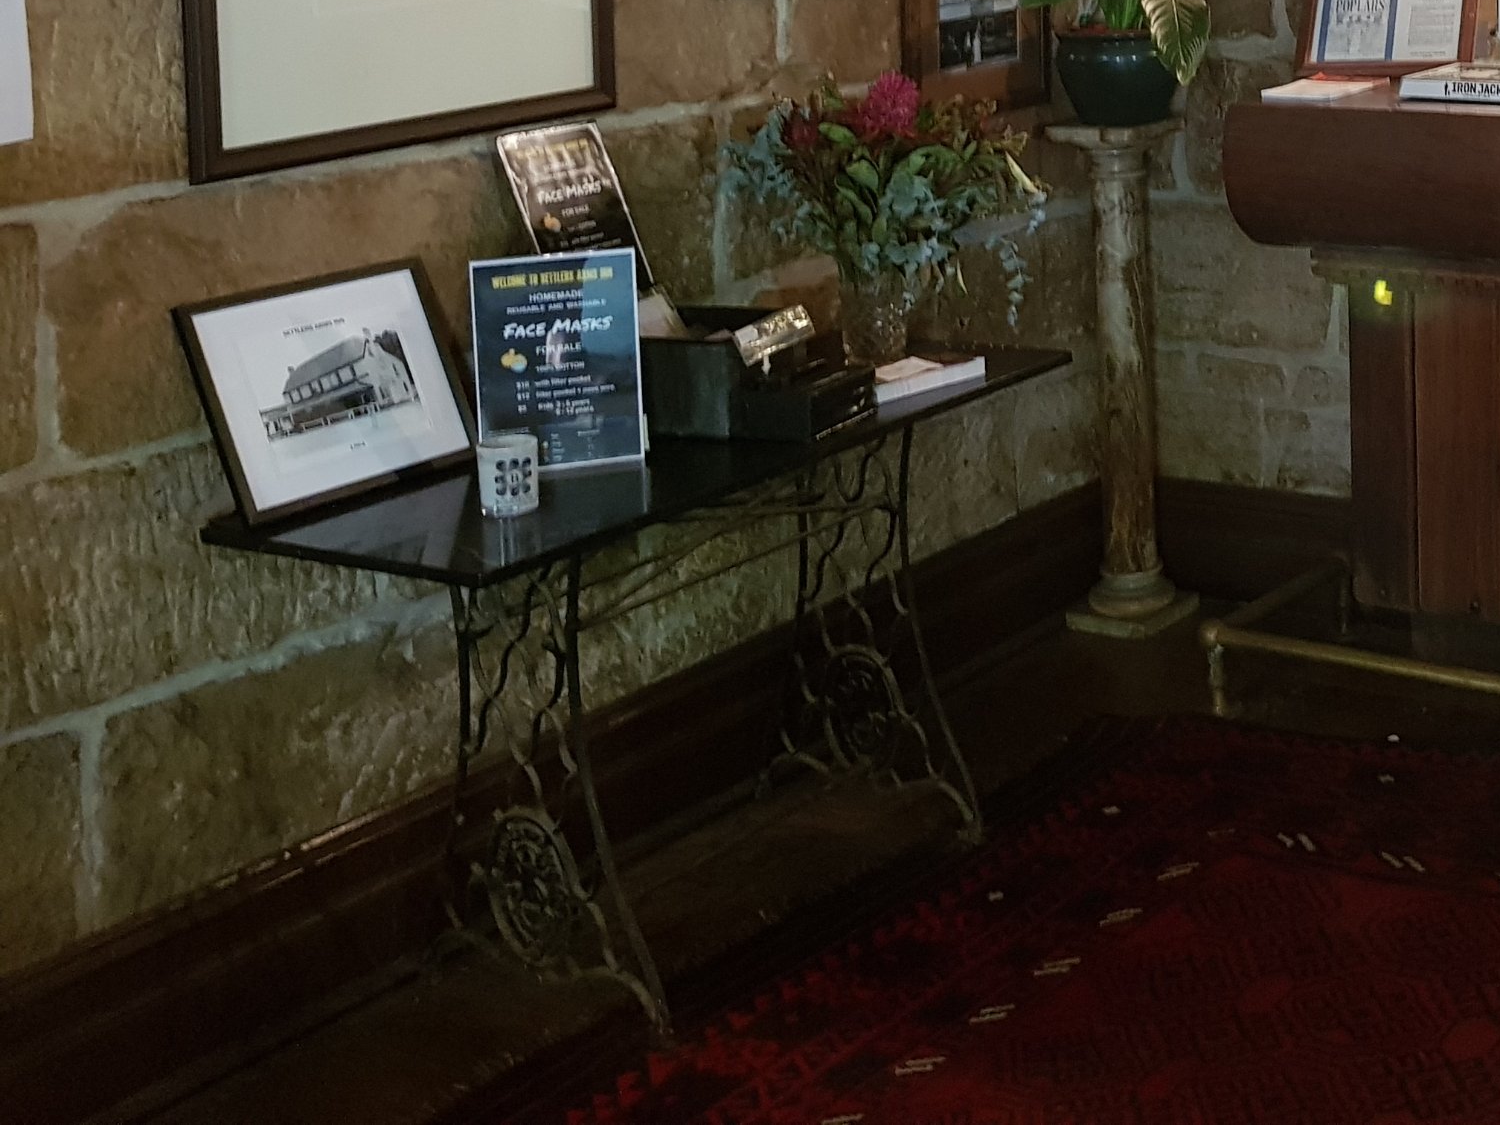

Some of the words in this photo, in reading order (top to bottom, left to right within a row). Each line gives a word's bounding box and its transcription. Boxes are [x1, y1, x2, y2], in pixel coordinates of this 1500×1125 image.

[1452, 81, 1477, 93] IRON
[529, 288, 583, 303] HOMEMADE
[548, 302, 564, 312] AND
[503, 321, 547, 340] FACE
[551, 315, 614, 334] MASKS
[535, 343, 556, 355] FOR
[557, 341, 582, 353] SALE
